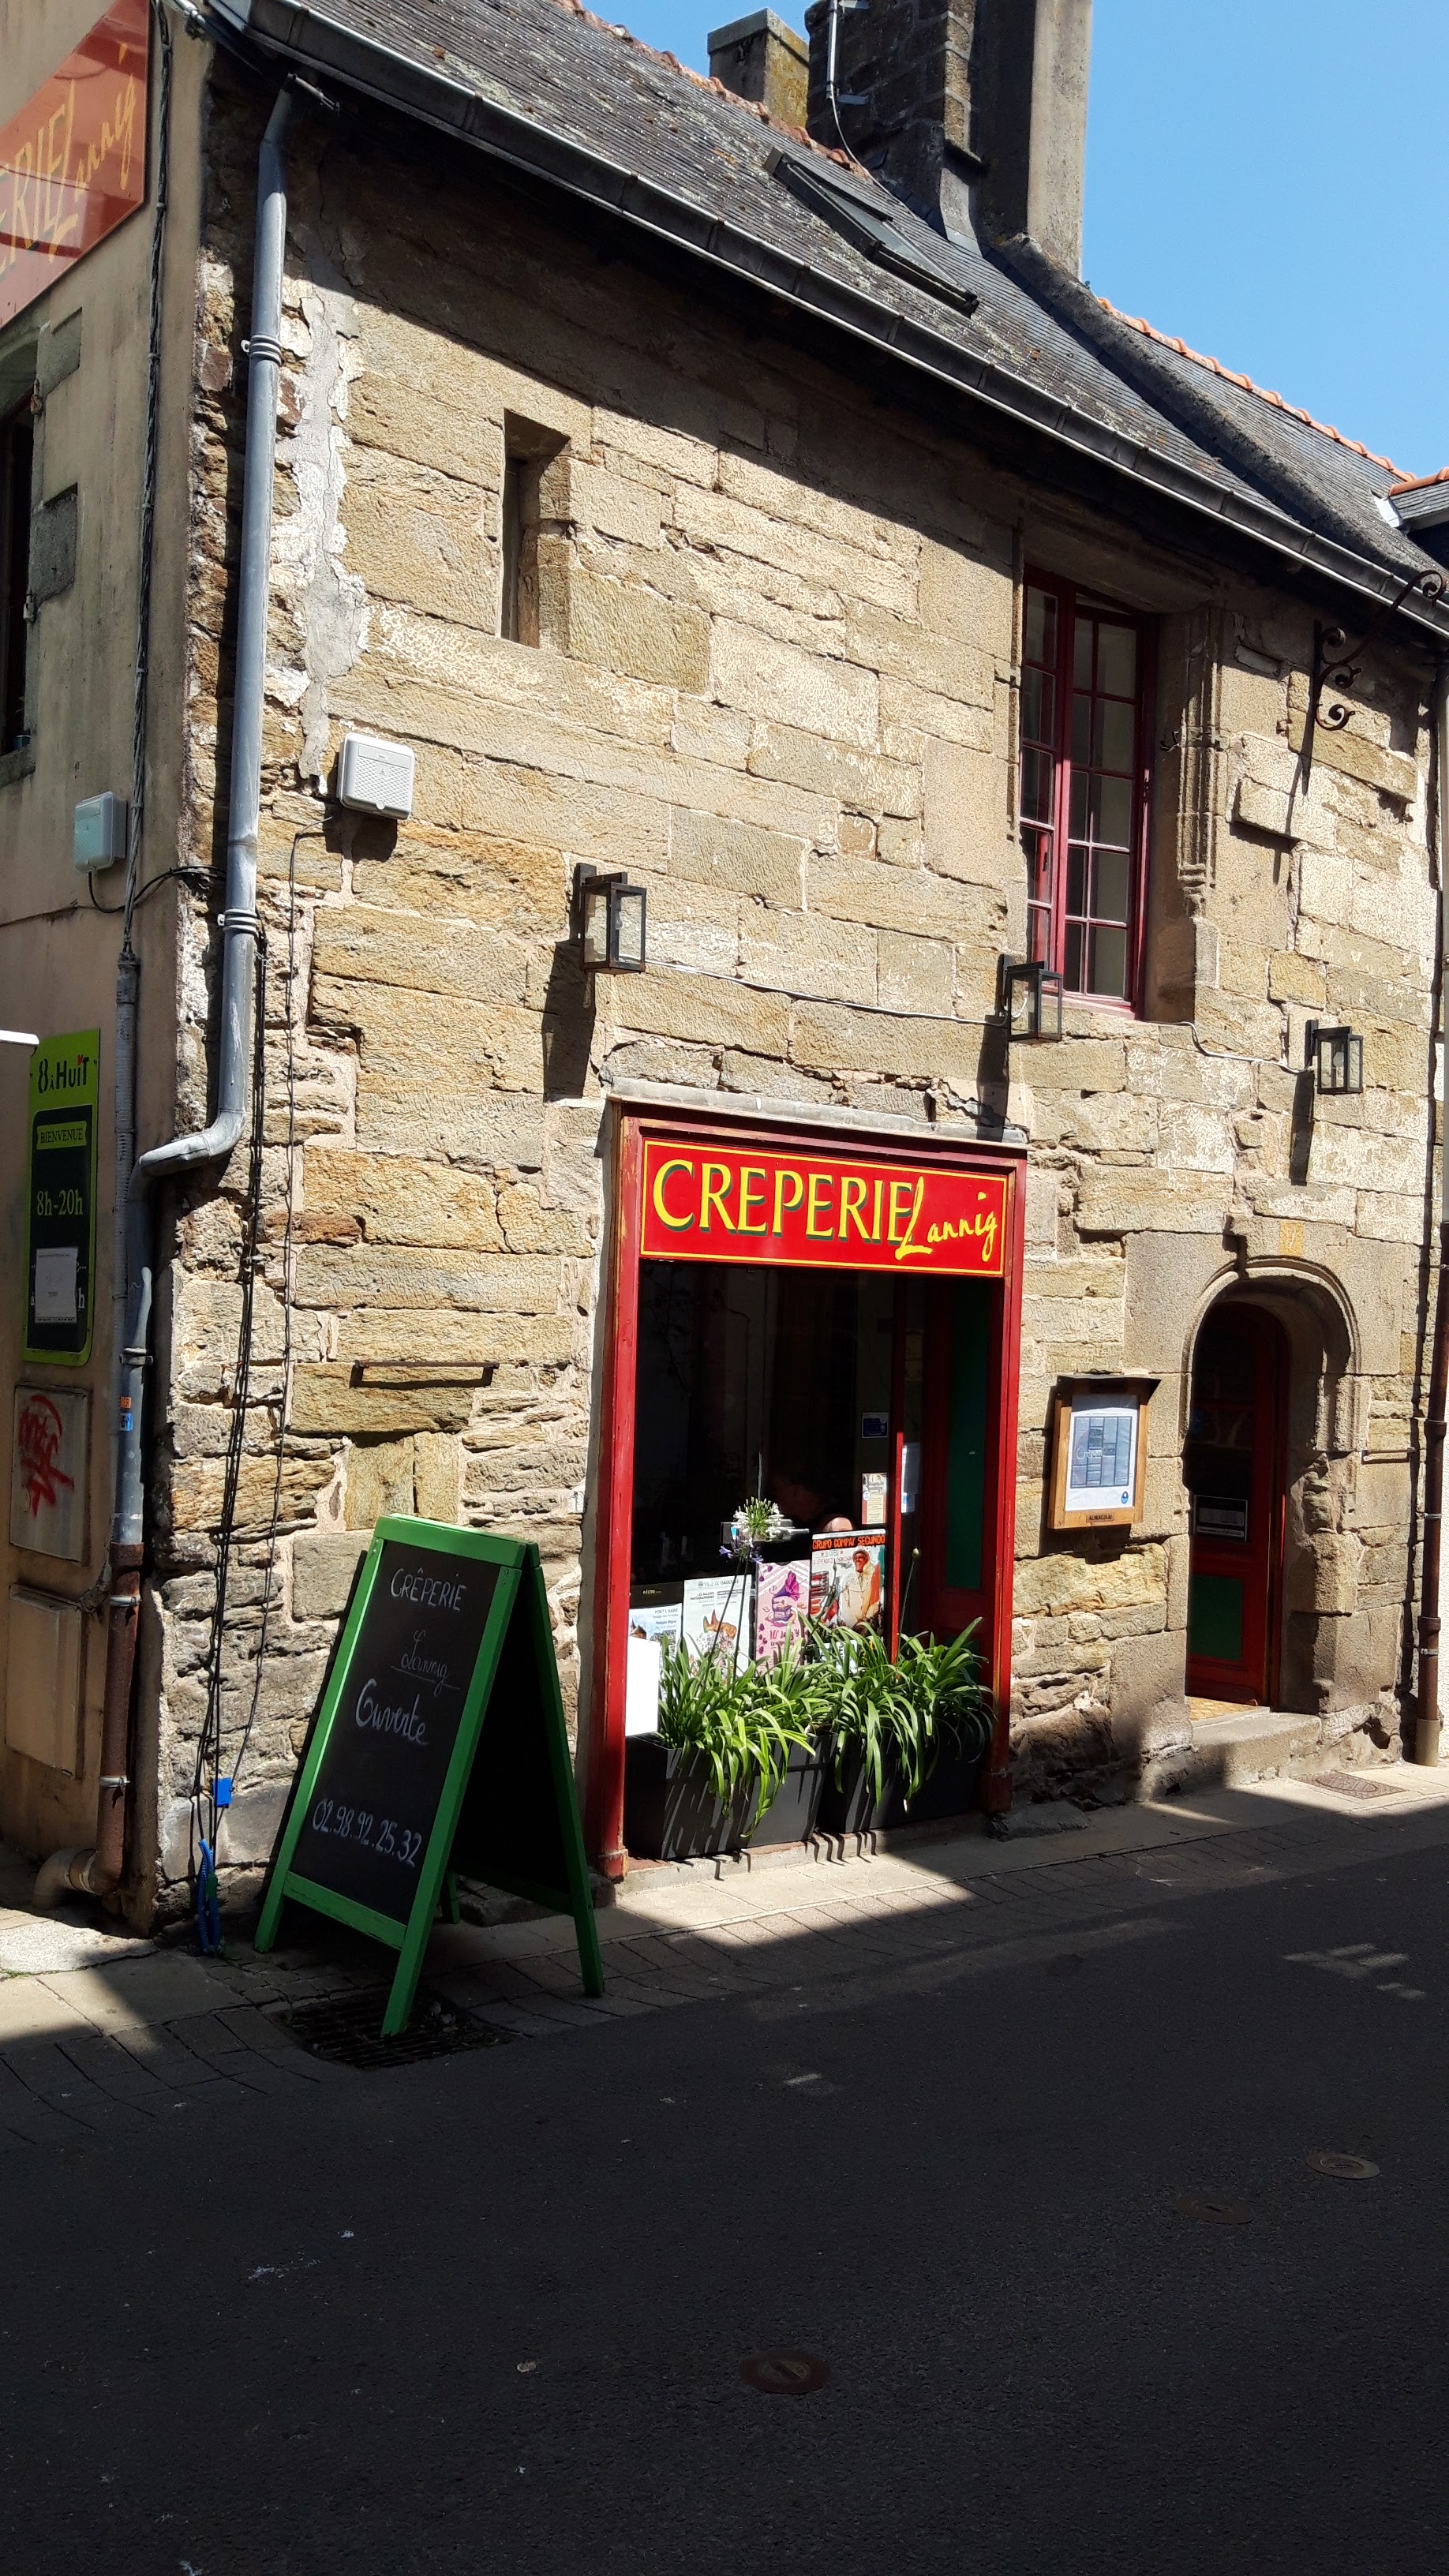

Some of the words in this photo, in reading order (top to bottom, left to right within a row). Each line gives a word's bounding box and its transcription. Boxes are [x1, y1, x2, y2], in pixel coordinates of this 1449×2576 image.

[38, 1058, 48, 1094] 8
[40, 1129, 83, 1144] BIENVENUE
[36, 1189, 84, 1216] 8h-20h
[653, 1159, 912, 1243] CREPERIE
[896, 1176, 998, 1261] Lannig
[812, 1539, 832, 1550] GRUPO
[858, 1535, 886, 1545] SEGUNDO
[391, 1567, 466, 1612] CRÊPERIE
